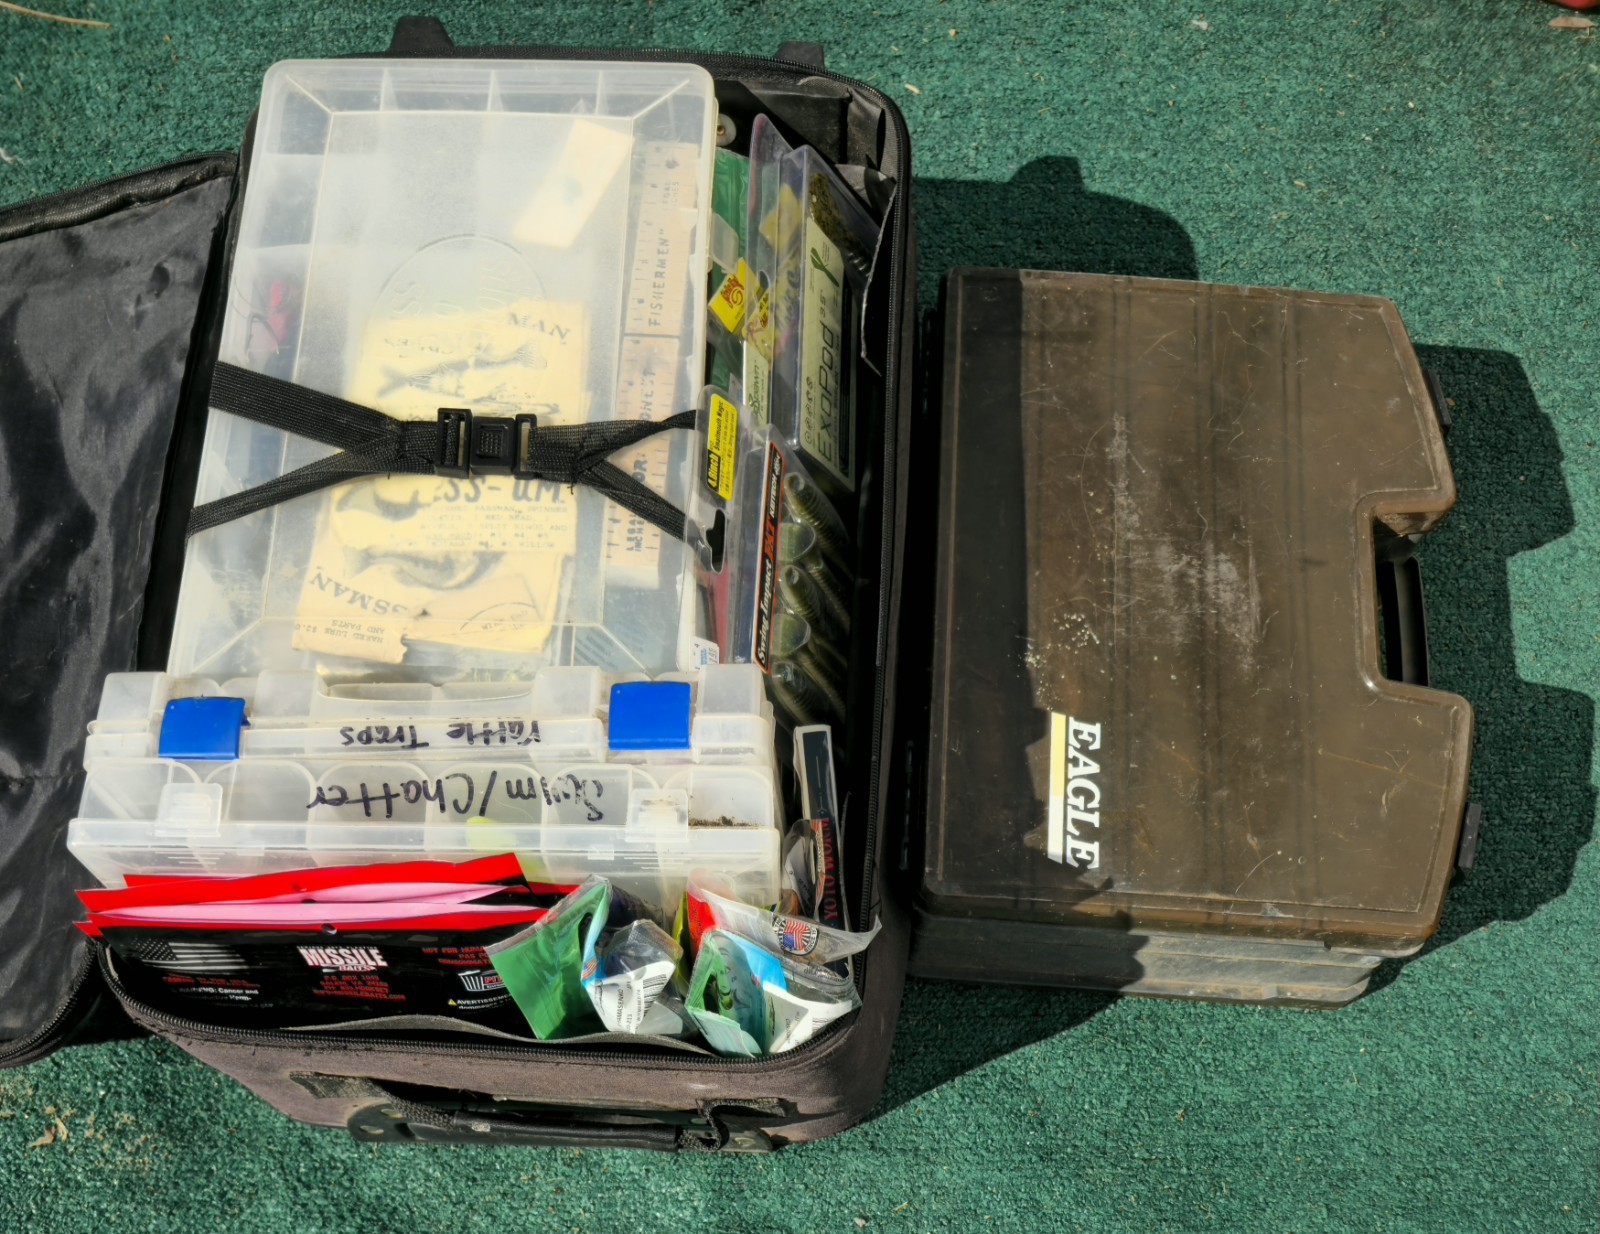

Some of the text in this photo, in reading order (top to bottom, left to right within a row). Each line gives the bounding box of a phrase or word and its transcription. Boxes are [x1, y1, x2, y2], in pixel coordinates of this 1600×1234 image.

[769, 473, 779, 519] KEITECH
[635, 518, 645, 552] INCHE
[764, 513, 775, 561] FAT
[760, 558, 772, 617] Impact
[331, 619, 385, 636] AND PARTS
[758, 615, 769, 664] Swing
[1067, 717, 1101, 869] EAGLE
[296, 946, 388, 968] MISSILE
[338, 964, 374, 973] BAITS
